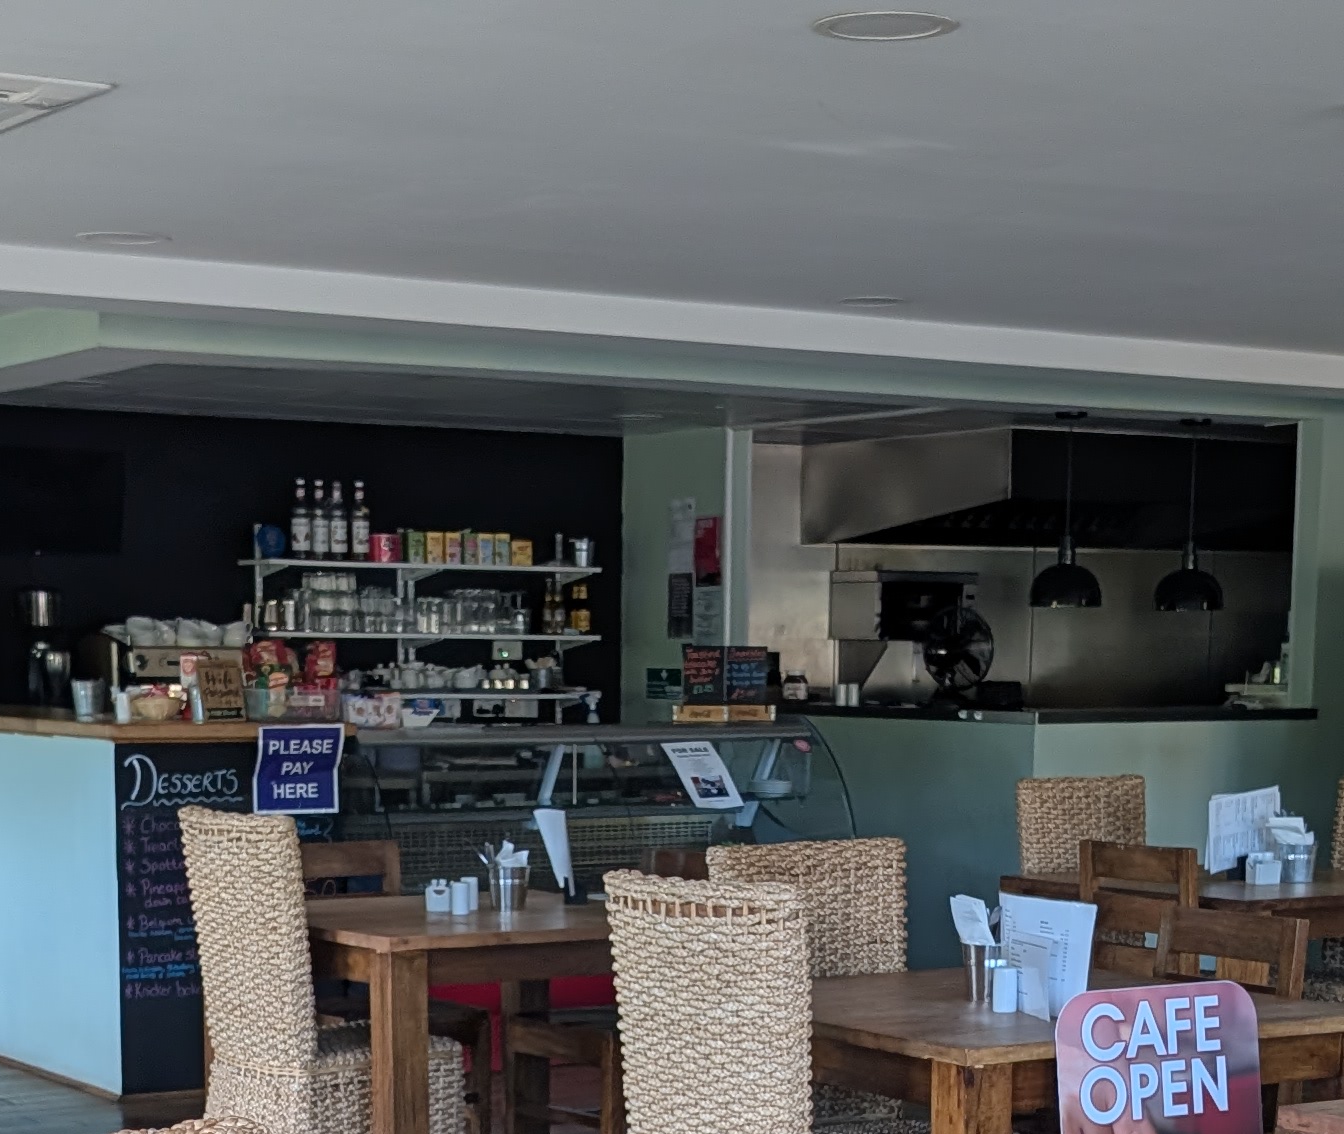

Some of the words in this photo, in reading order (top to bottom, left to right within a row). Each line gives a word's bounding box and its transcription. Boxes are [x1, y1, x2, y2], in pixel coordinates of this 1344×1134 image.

[268, 739, 334, 755] PLEASE
[280, 761, 315, 776] PAY
[272, 782, 320, 799] HERE
[1080, 994, 1222, 1062] CAFE
[1079, 1055, 1229, 1126] OPEN
